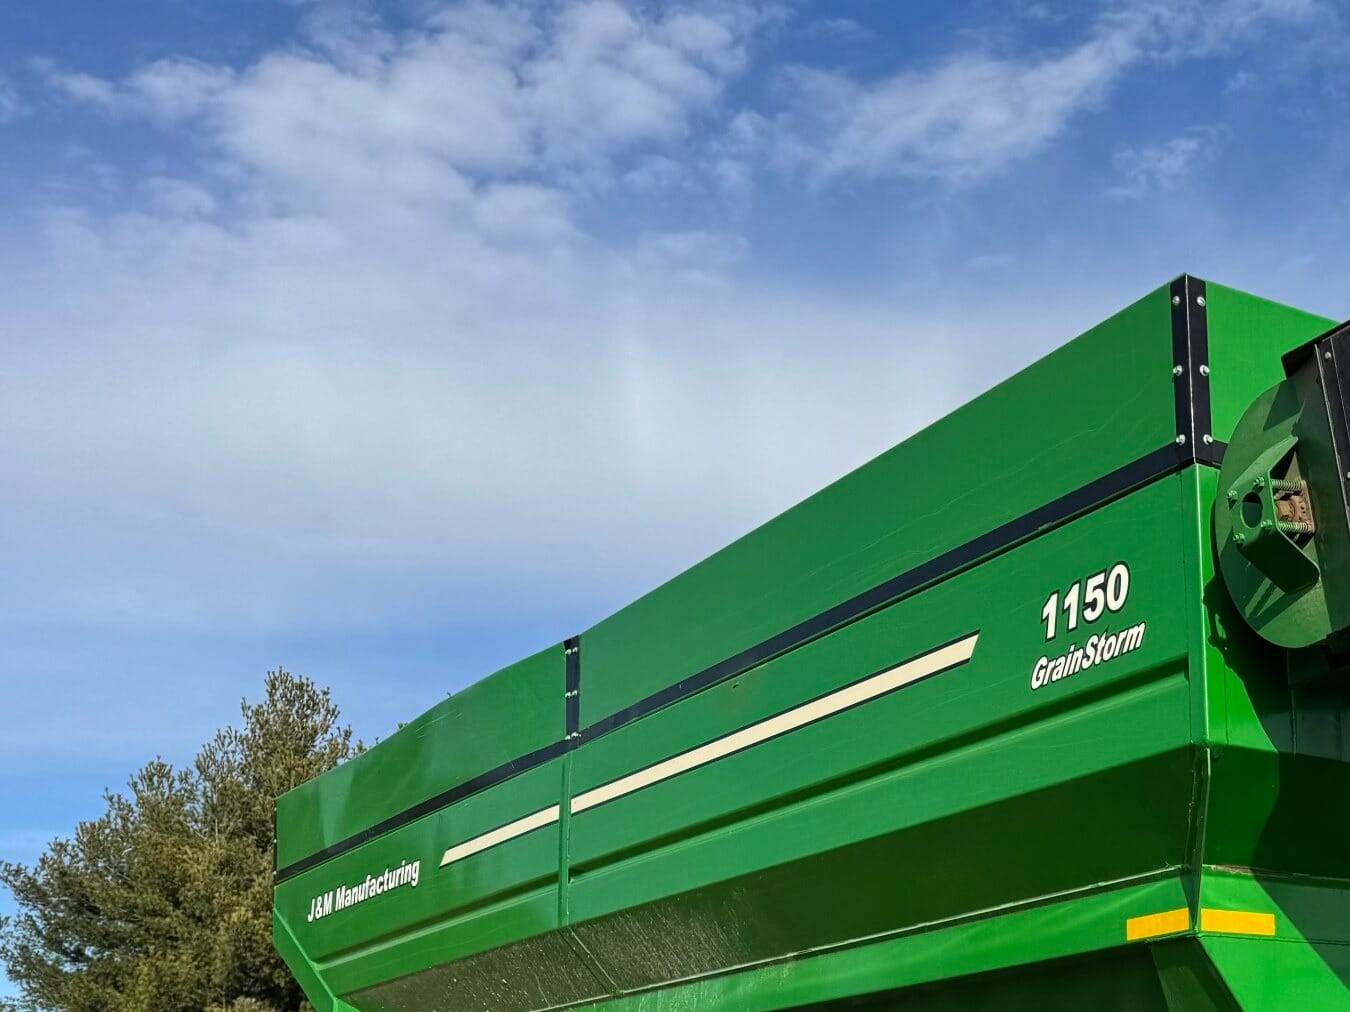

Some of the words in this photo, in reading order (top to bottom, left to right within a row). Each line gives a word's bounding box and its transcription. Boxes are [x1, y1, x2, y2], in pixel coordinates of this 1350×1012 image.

[1041, 562, 1130, 641] 1150
[1031, 622, 1146, 690] GrainStorm
[307, 890, 334, 922] J&M
[335, 860, 420, 911] Manufacturing
